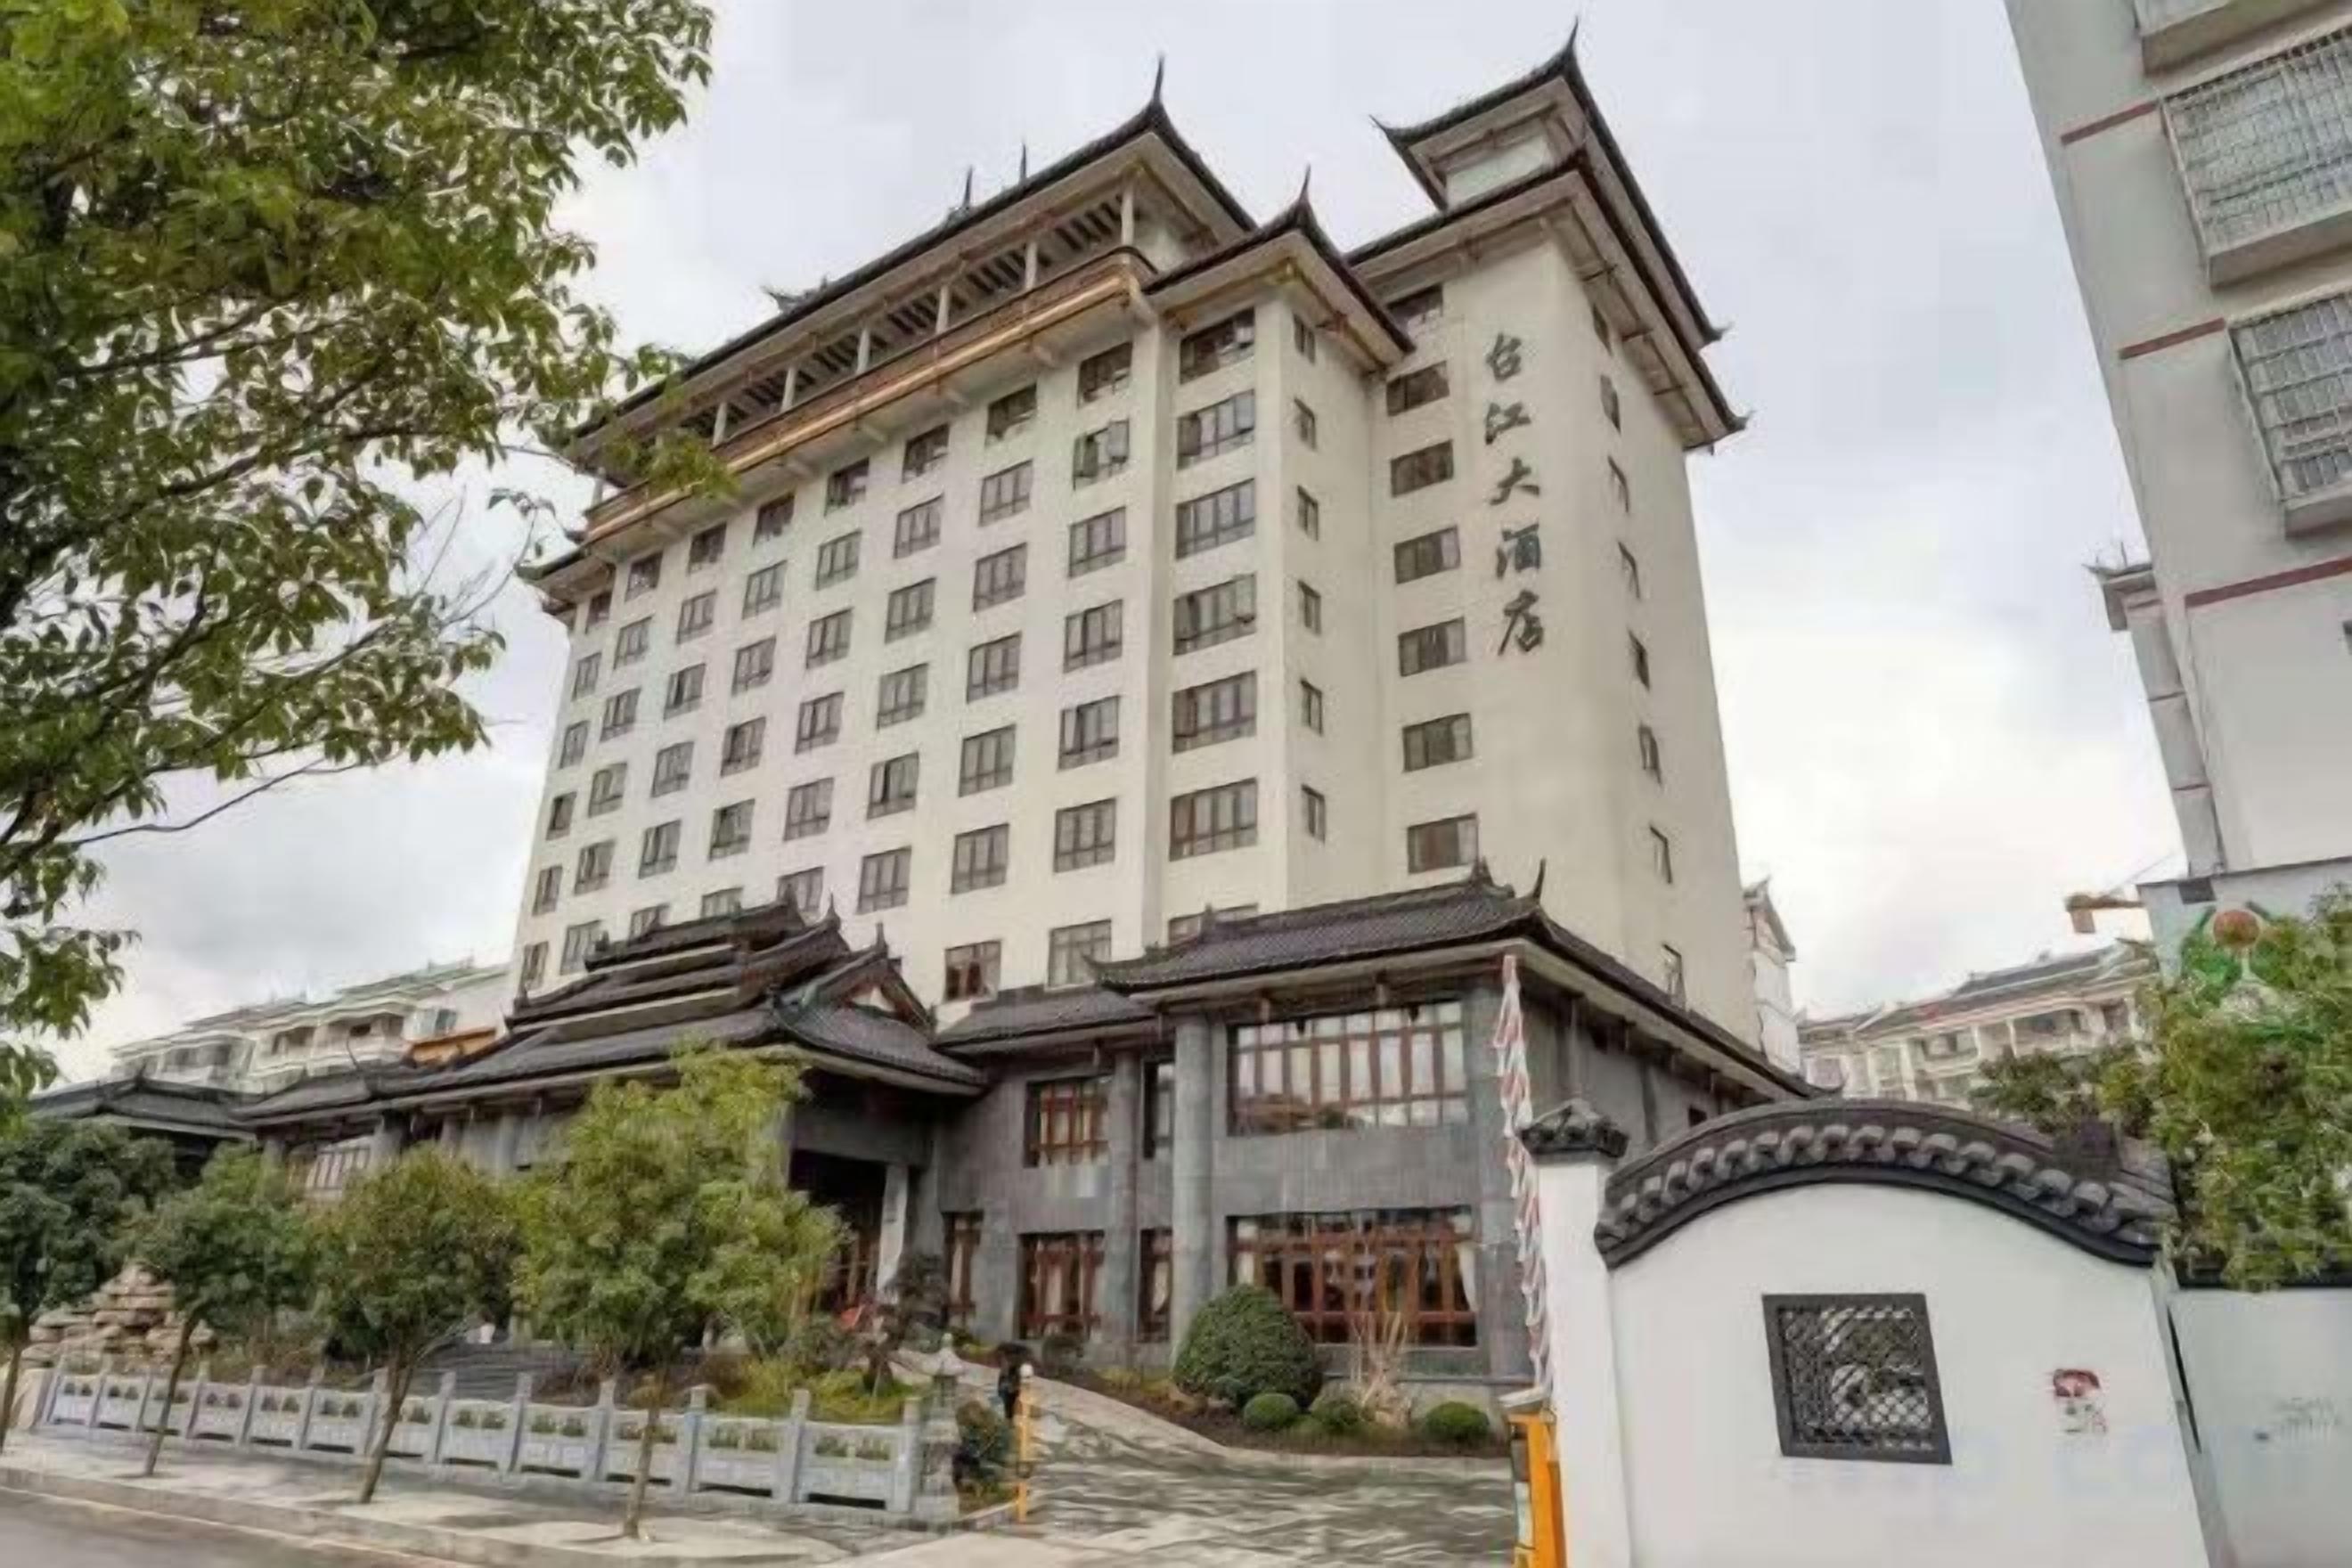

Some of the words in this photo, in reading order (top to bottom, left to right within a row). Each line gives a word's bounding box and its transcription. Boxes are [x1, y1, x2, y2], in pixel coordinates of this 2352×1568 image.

[1484, 331, 1544, 657] 台江大酒店
